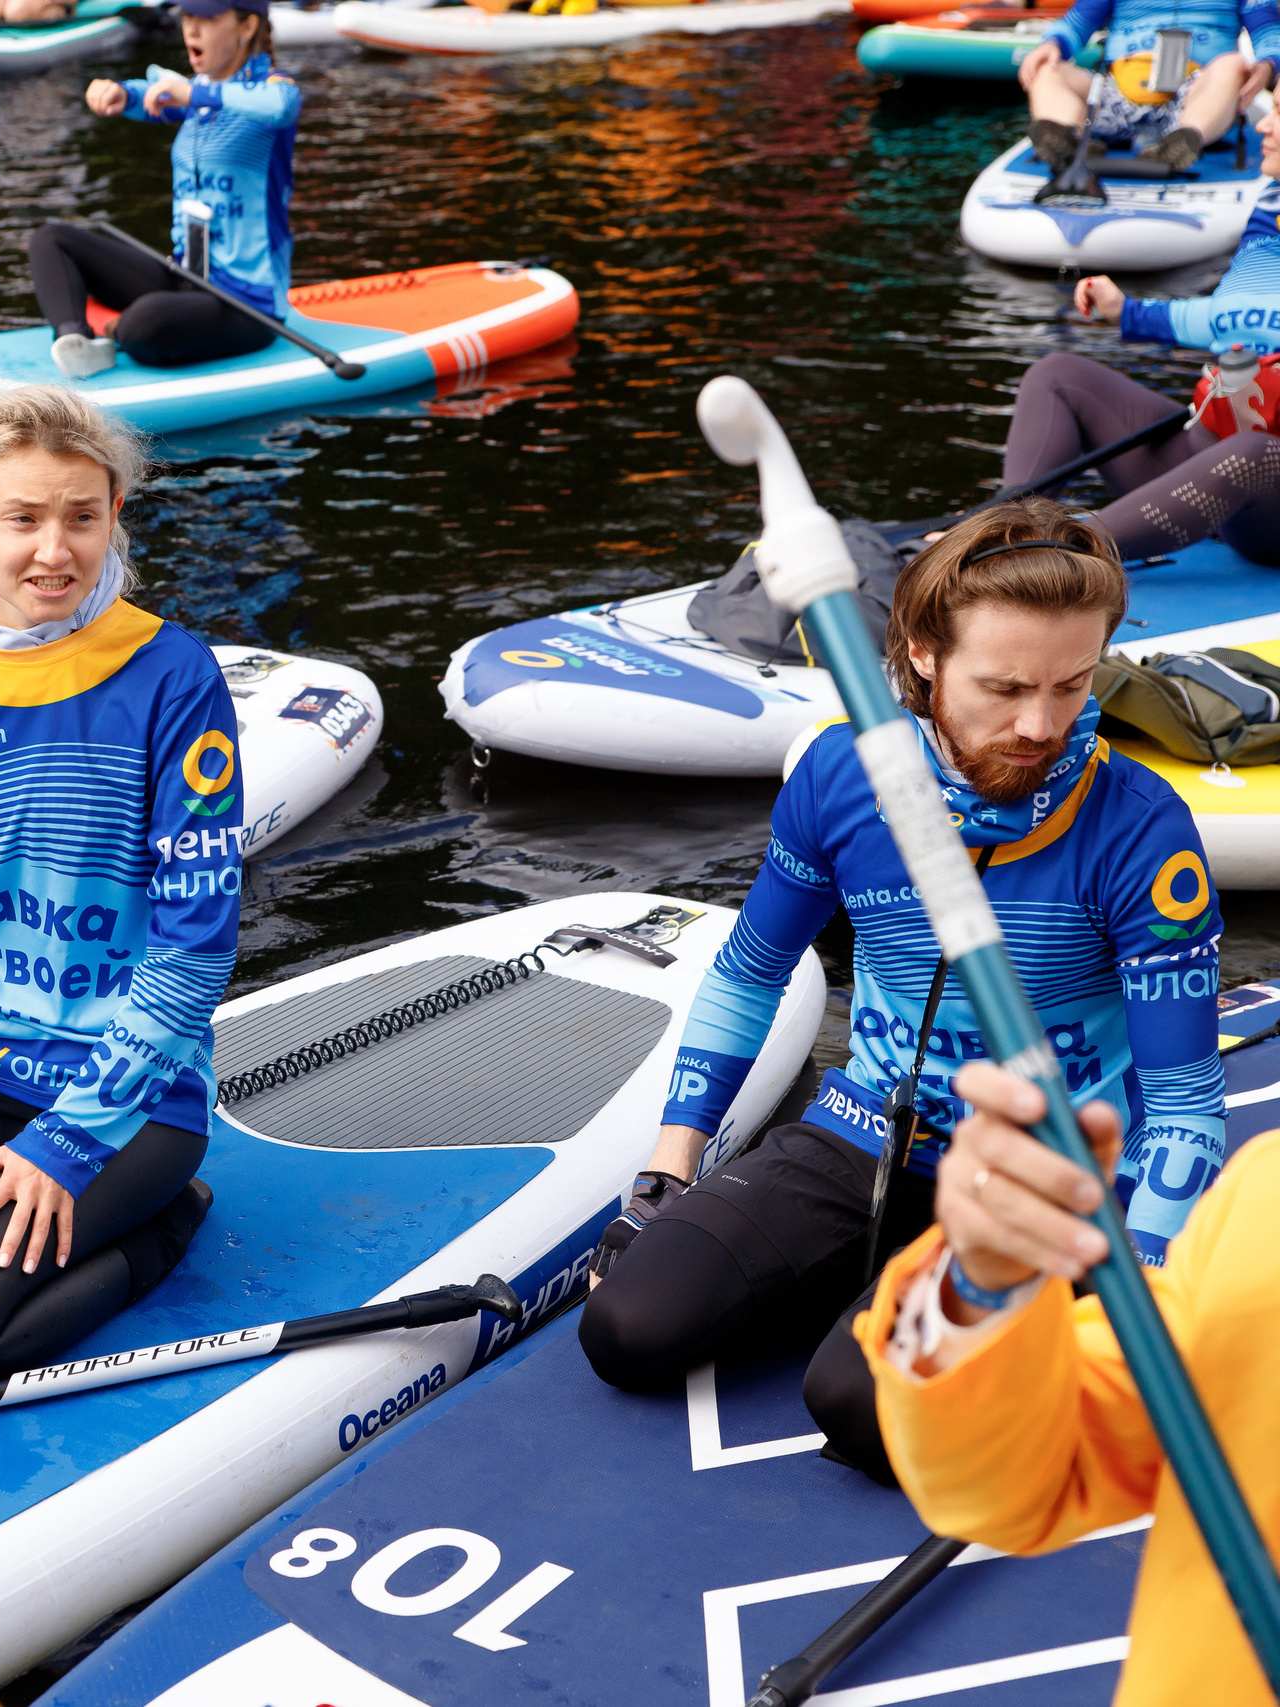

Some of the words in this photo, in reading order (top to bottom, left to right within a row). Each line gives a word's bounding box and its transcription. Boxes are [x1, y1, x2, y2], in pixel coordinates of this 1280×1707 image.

[320, 693, 365, 738] 0343
[666, 1070, 708, 1103] UP
[22, 1326, 263, 1385] HYDRO-FORCE
[338, 1362, 447, 1451] Oceana
